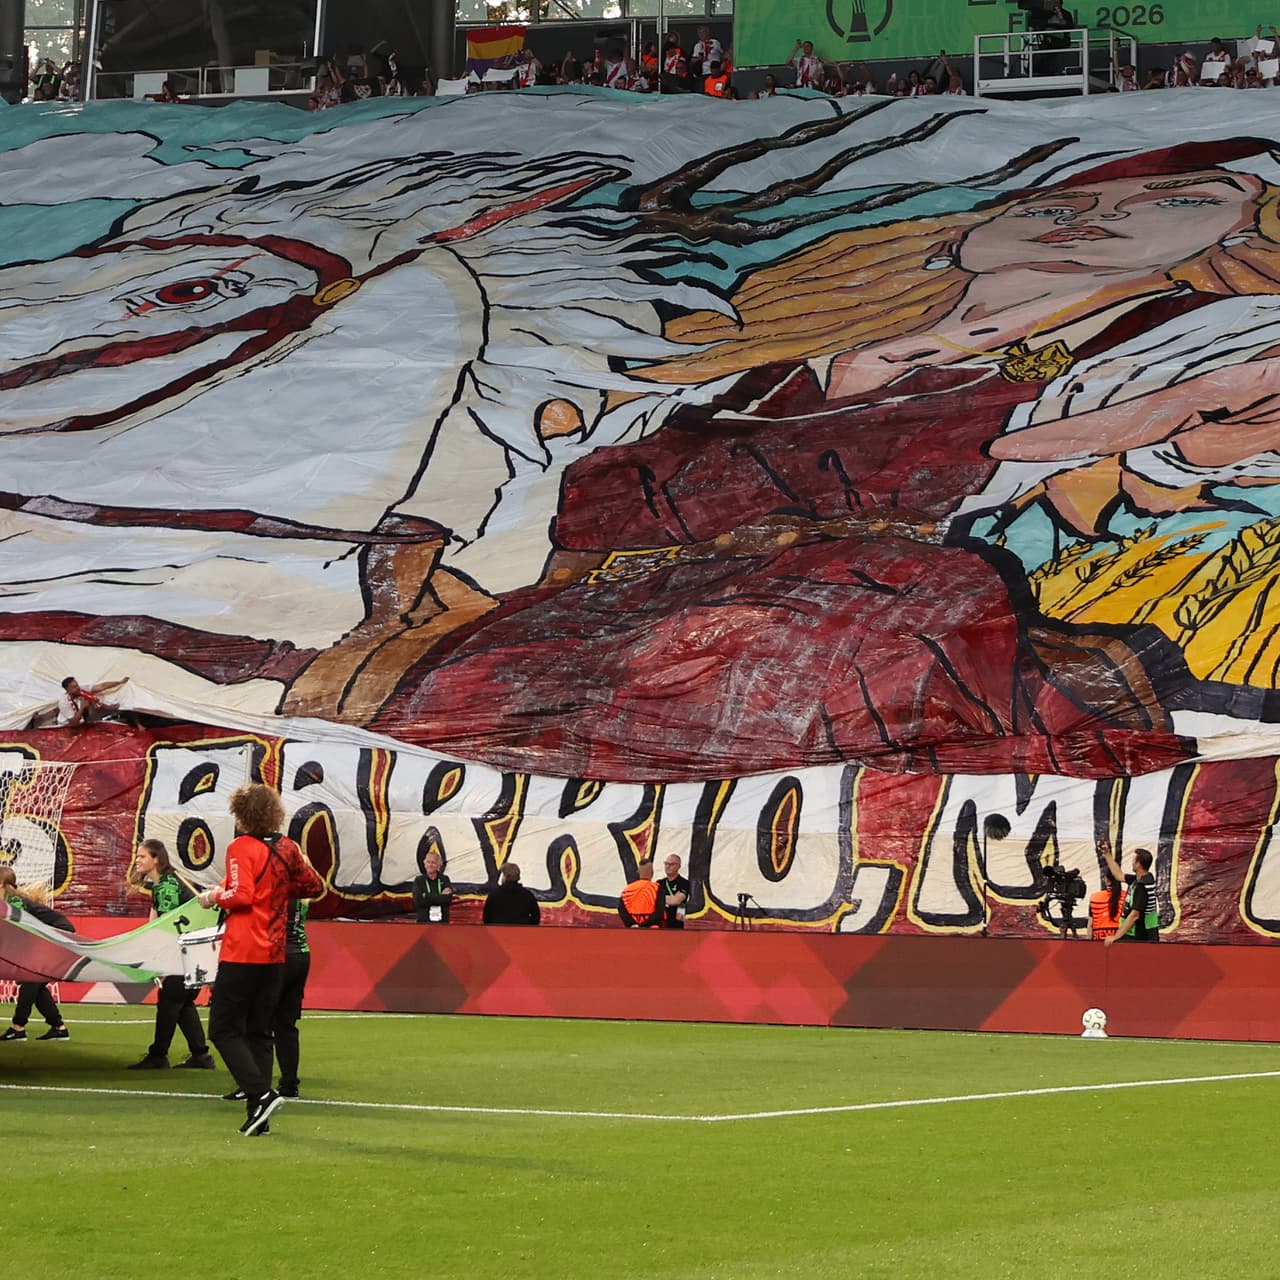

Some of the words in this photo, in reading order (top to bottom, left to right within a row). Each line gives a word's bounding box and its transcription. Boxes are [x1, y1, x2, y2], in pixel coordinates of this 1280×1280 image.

[1095, 3, 1165, 29] 2026
[127, 736, 910, 934] BARRIO,
[909, 762, 1200, 936] MI
